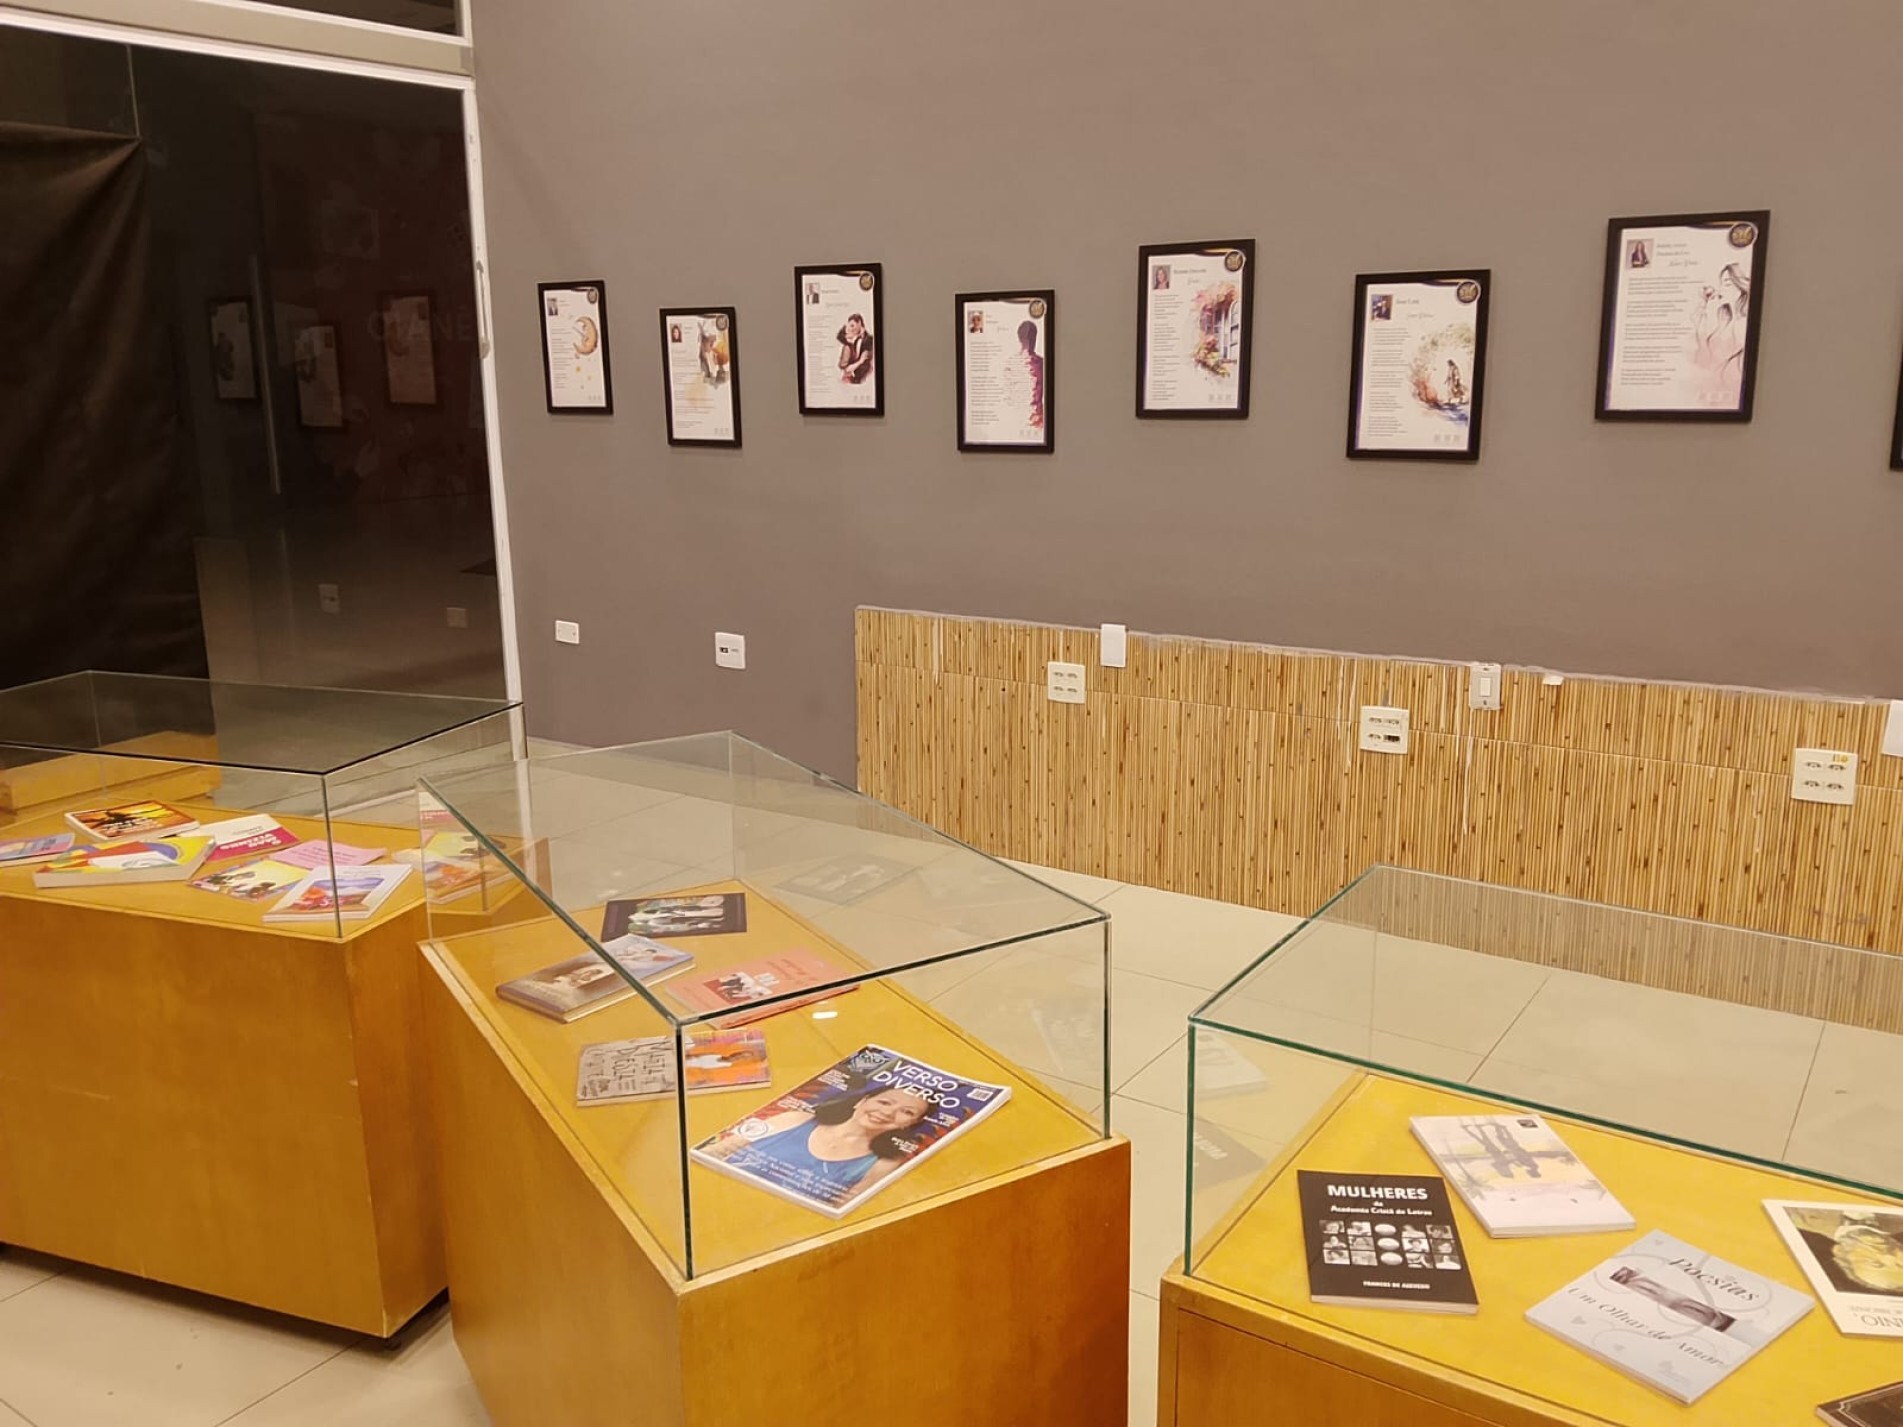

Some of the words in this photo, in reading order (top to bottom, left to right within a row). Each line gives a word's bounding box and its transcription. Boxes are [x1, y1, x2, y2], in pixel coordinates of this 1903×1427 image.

[872, 1071, 960, 1108] DIVERSO
[893, 1060, 958, 1091] VERSO
[1327, 1185, 1428, 1200] MULHERES
[1668, 1257, 1760, 1301] Poesias
[1568, 1287, 1597, 1305] Um
[1599, 1303, 1649, 1330] Olhar
[1648, 1329, 1673, 1341] de
[1678, 1341, 1727, 1366] Amor
